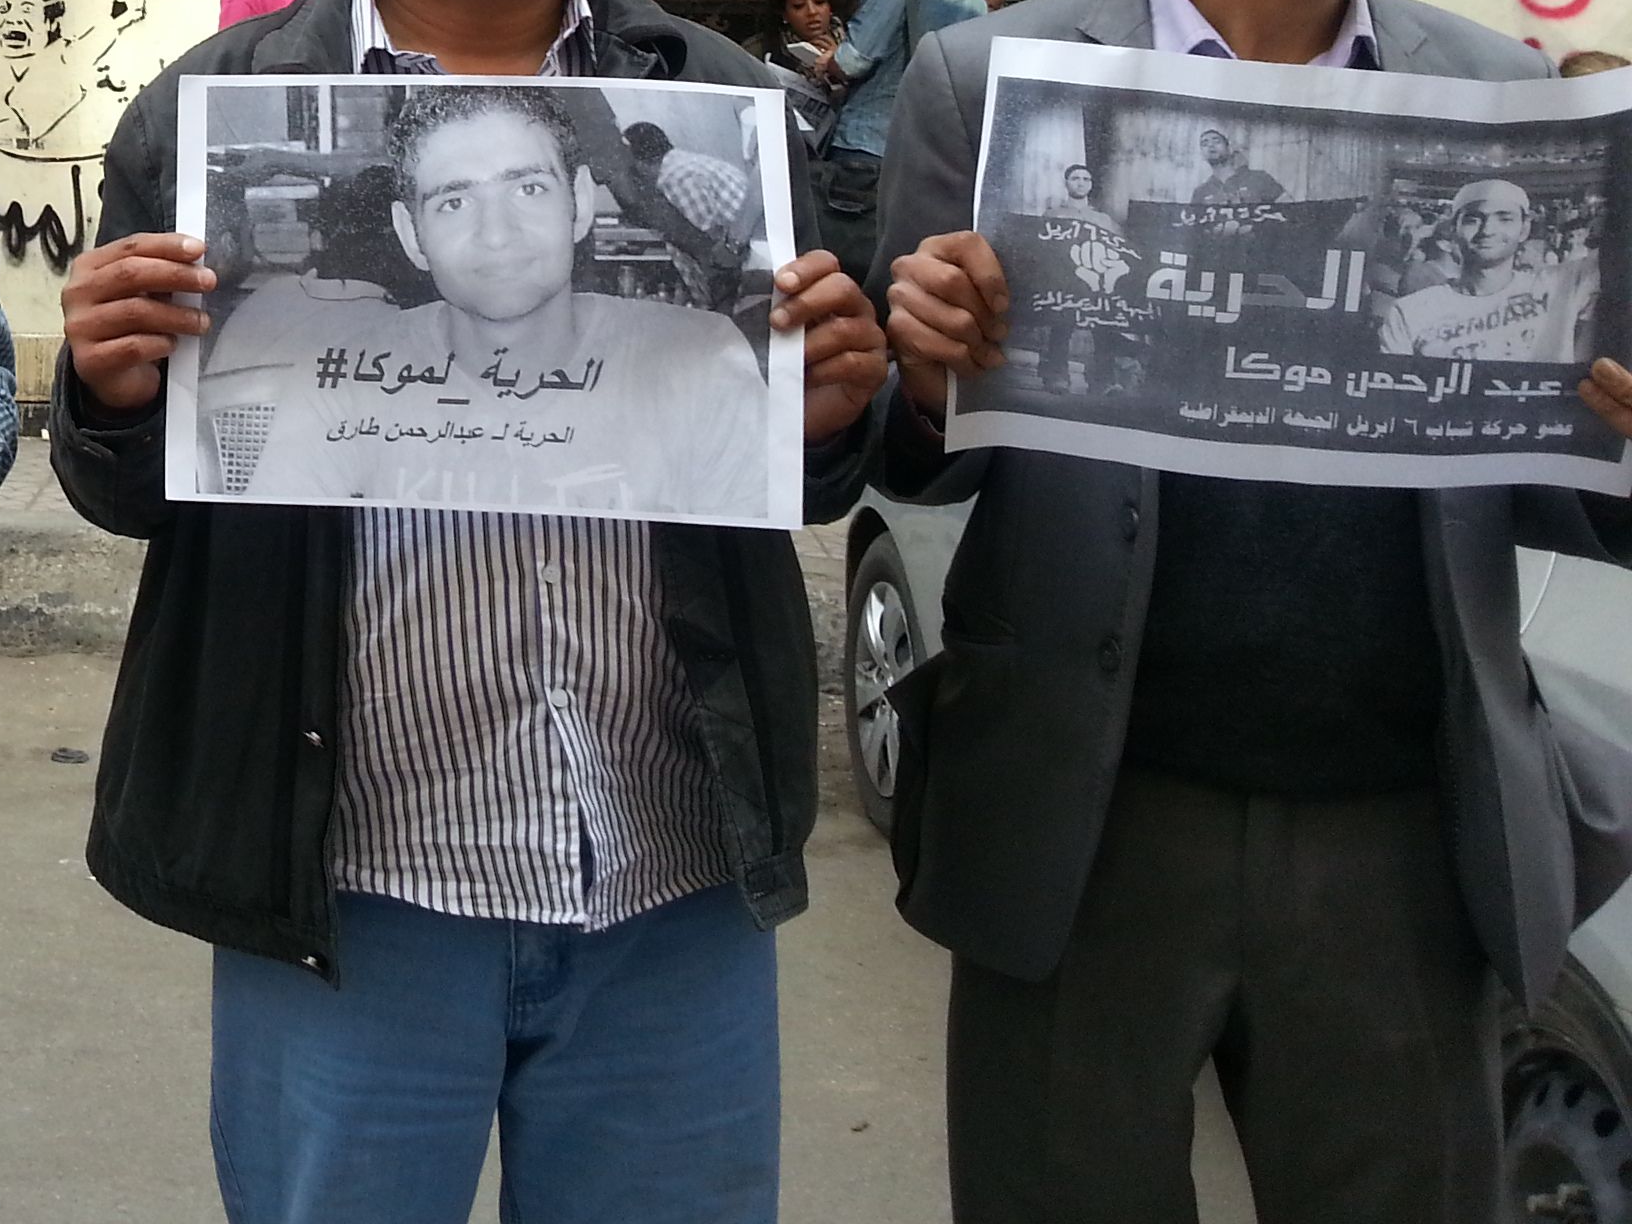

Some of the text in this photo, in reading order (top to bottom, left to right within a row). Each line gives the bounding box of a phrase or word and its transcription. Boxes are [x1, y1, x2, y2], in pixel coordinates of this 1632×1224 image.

[1146, 248, 1366, 324] الحرية
[1224, 345, 1565, 404] عبد الرحمن موكا
[325, 416, 380, 443] طارق
[384, 419, 485, 447] عبدالرحمن
[1282, 407, 1339, 433] الجبهة
[1345, 413, 1396, 439] ابريل
[1480, 419, 1529, 440] حركة
[513, 423, 575, 449] الحرية
